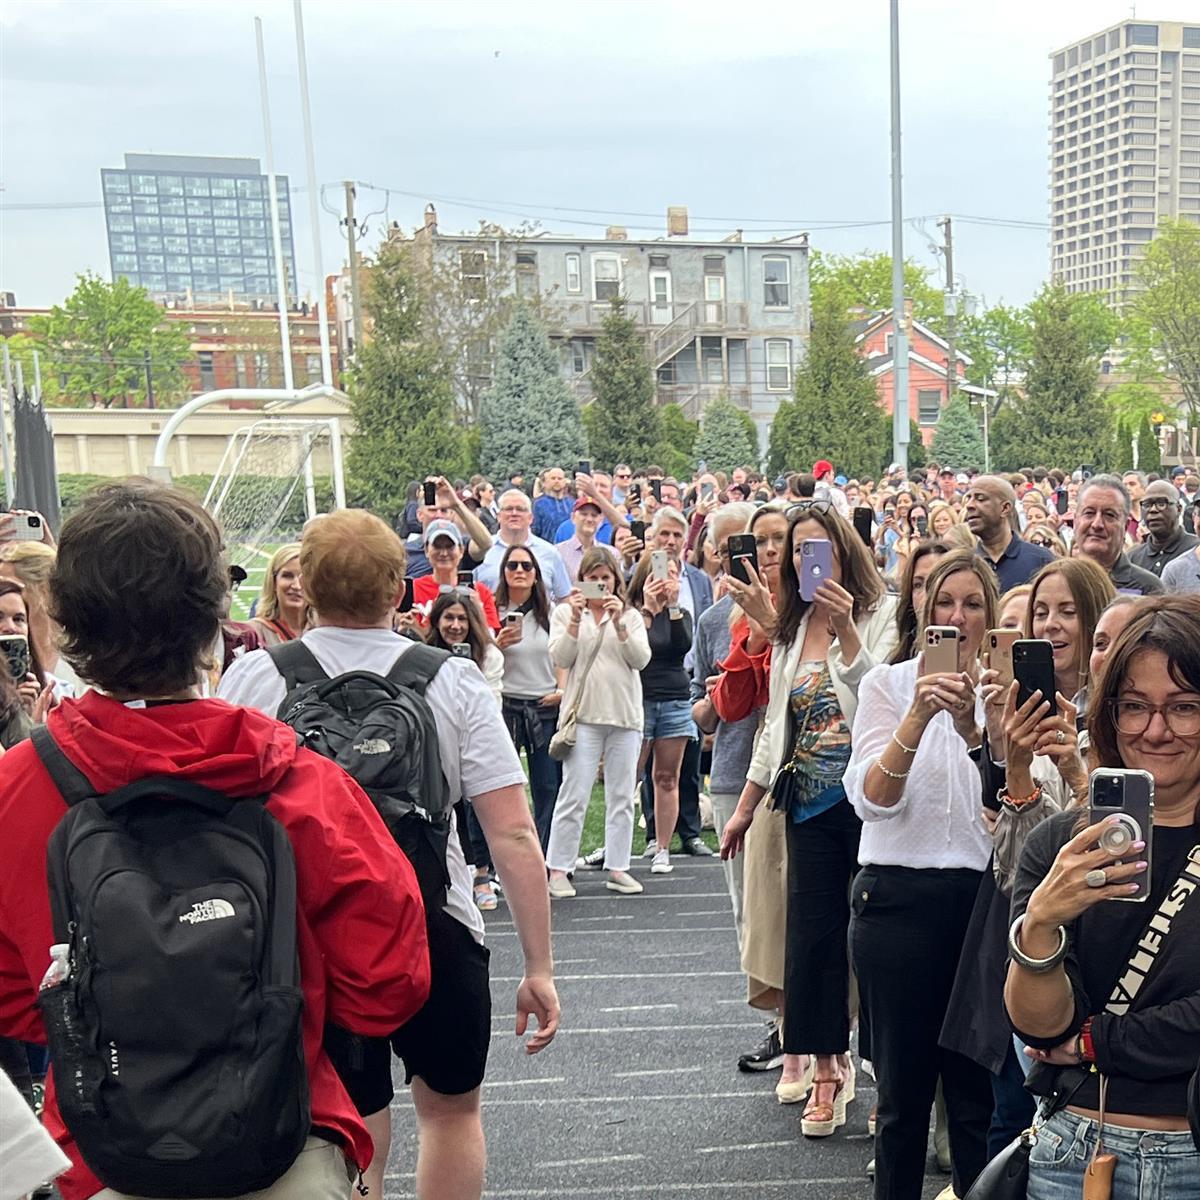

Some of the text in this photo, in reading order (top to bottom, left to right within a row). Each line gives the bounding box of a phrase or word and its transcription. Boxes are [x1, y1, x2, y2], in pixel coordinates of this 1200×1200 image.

[191, 900, 213, 911] THE
[179, 909, 215, 922] NORTH
[190, 915, 216, 924] FACE
[109, 1040, 119, 1076] VAULT
